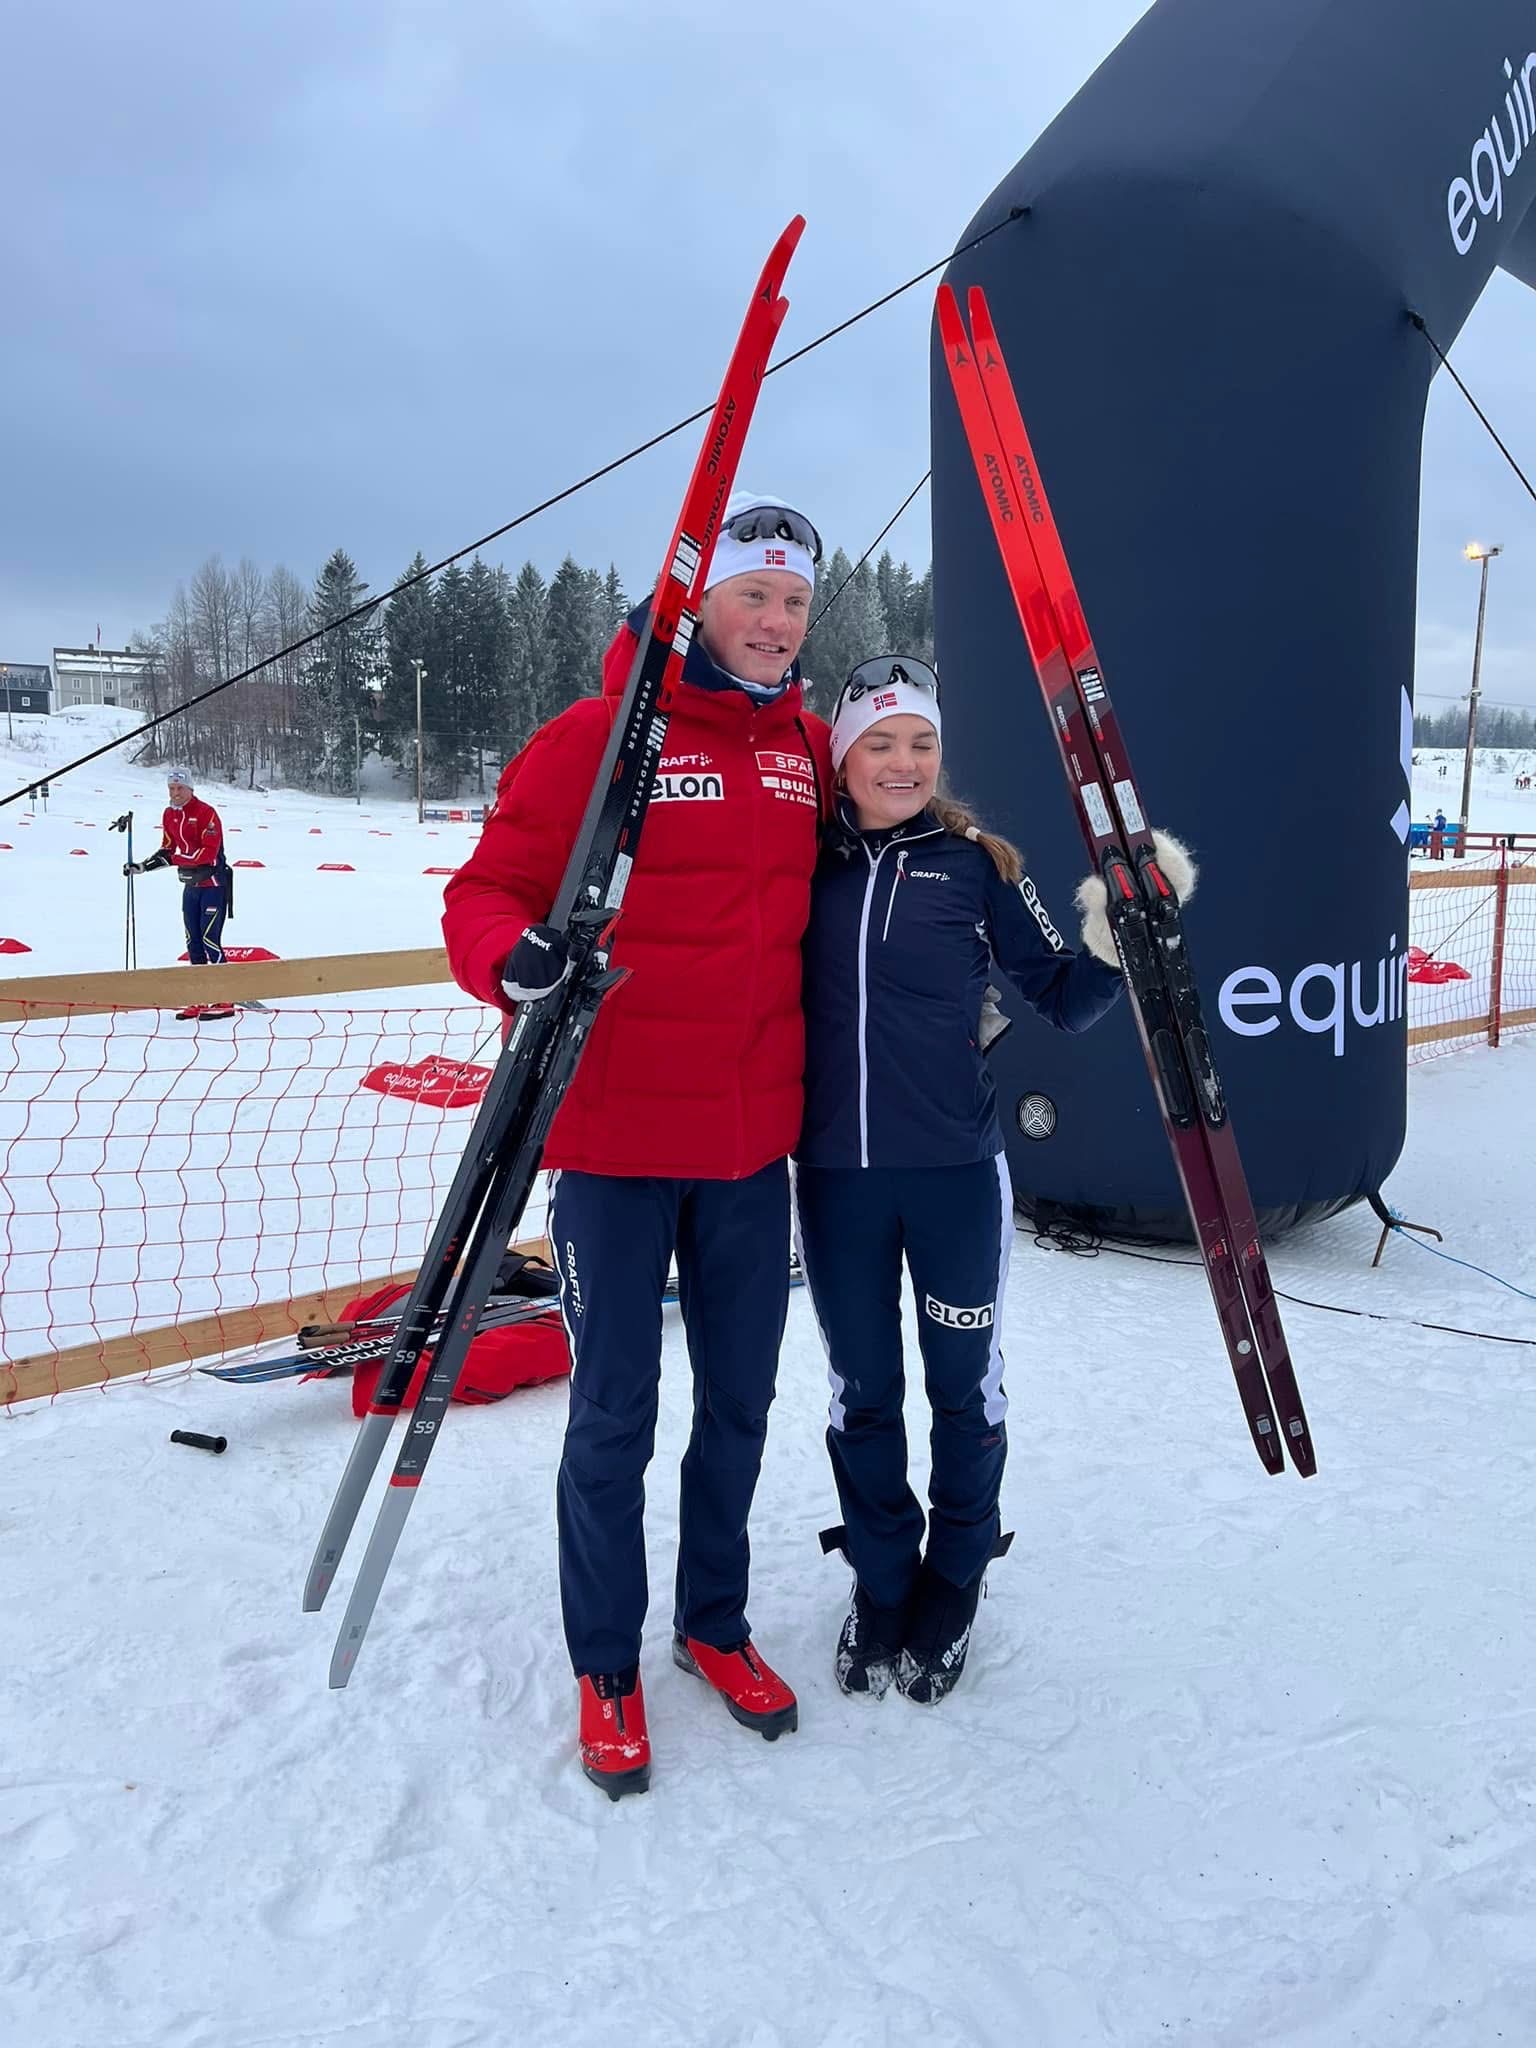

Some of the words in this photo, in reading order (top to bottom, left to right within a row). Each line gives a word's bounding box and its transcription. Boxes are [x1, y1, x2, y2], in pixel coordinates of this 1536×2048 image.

[706, 395, 737, 477] ATOMIC
[703, 474, 728, 549] ATOMIC
[984, 453, 1014, 522] ATOMIC
[1014, 454, 1044, 524] ATOMIC
[628, 680, 651, 750] REDSTER
[630, 749, 653, 817] REDSTER
[658, 754, 699, 769] RAFT
[775, 790, 788, 800] SKI
[910, 870, 942, 880] CRAFT
[566, 1240, 581, 1302] CRAFT
[307, 1334, 396, 1360] alomon
[394, 1350, 416, 1364] S9
[413, 1421, 436, 1434] S9
